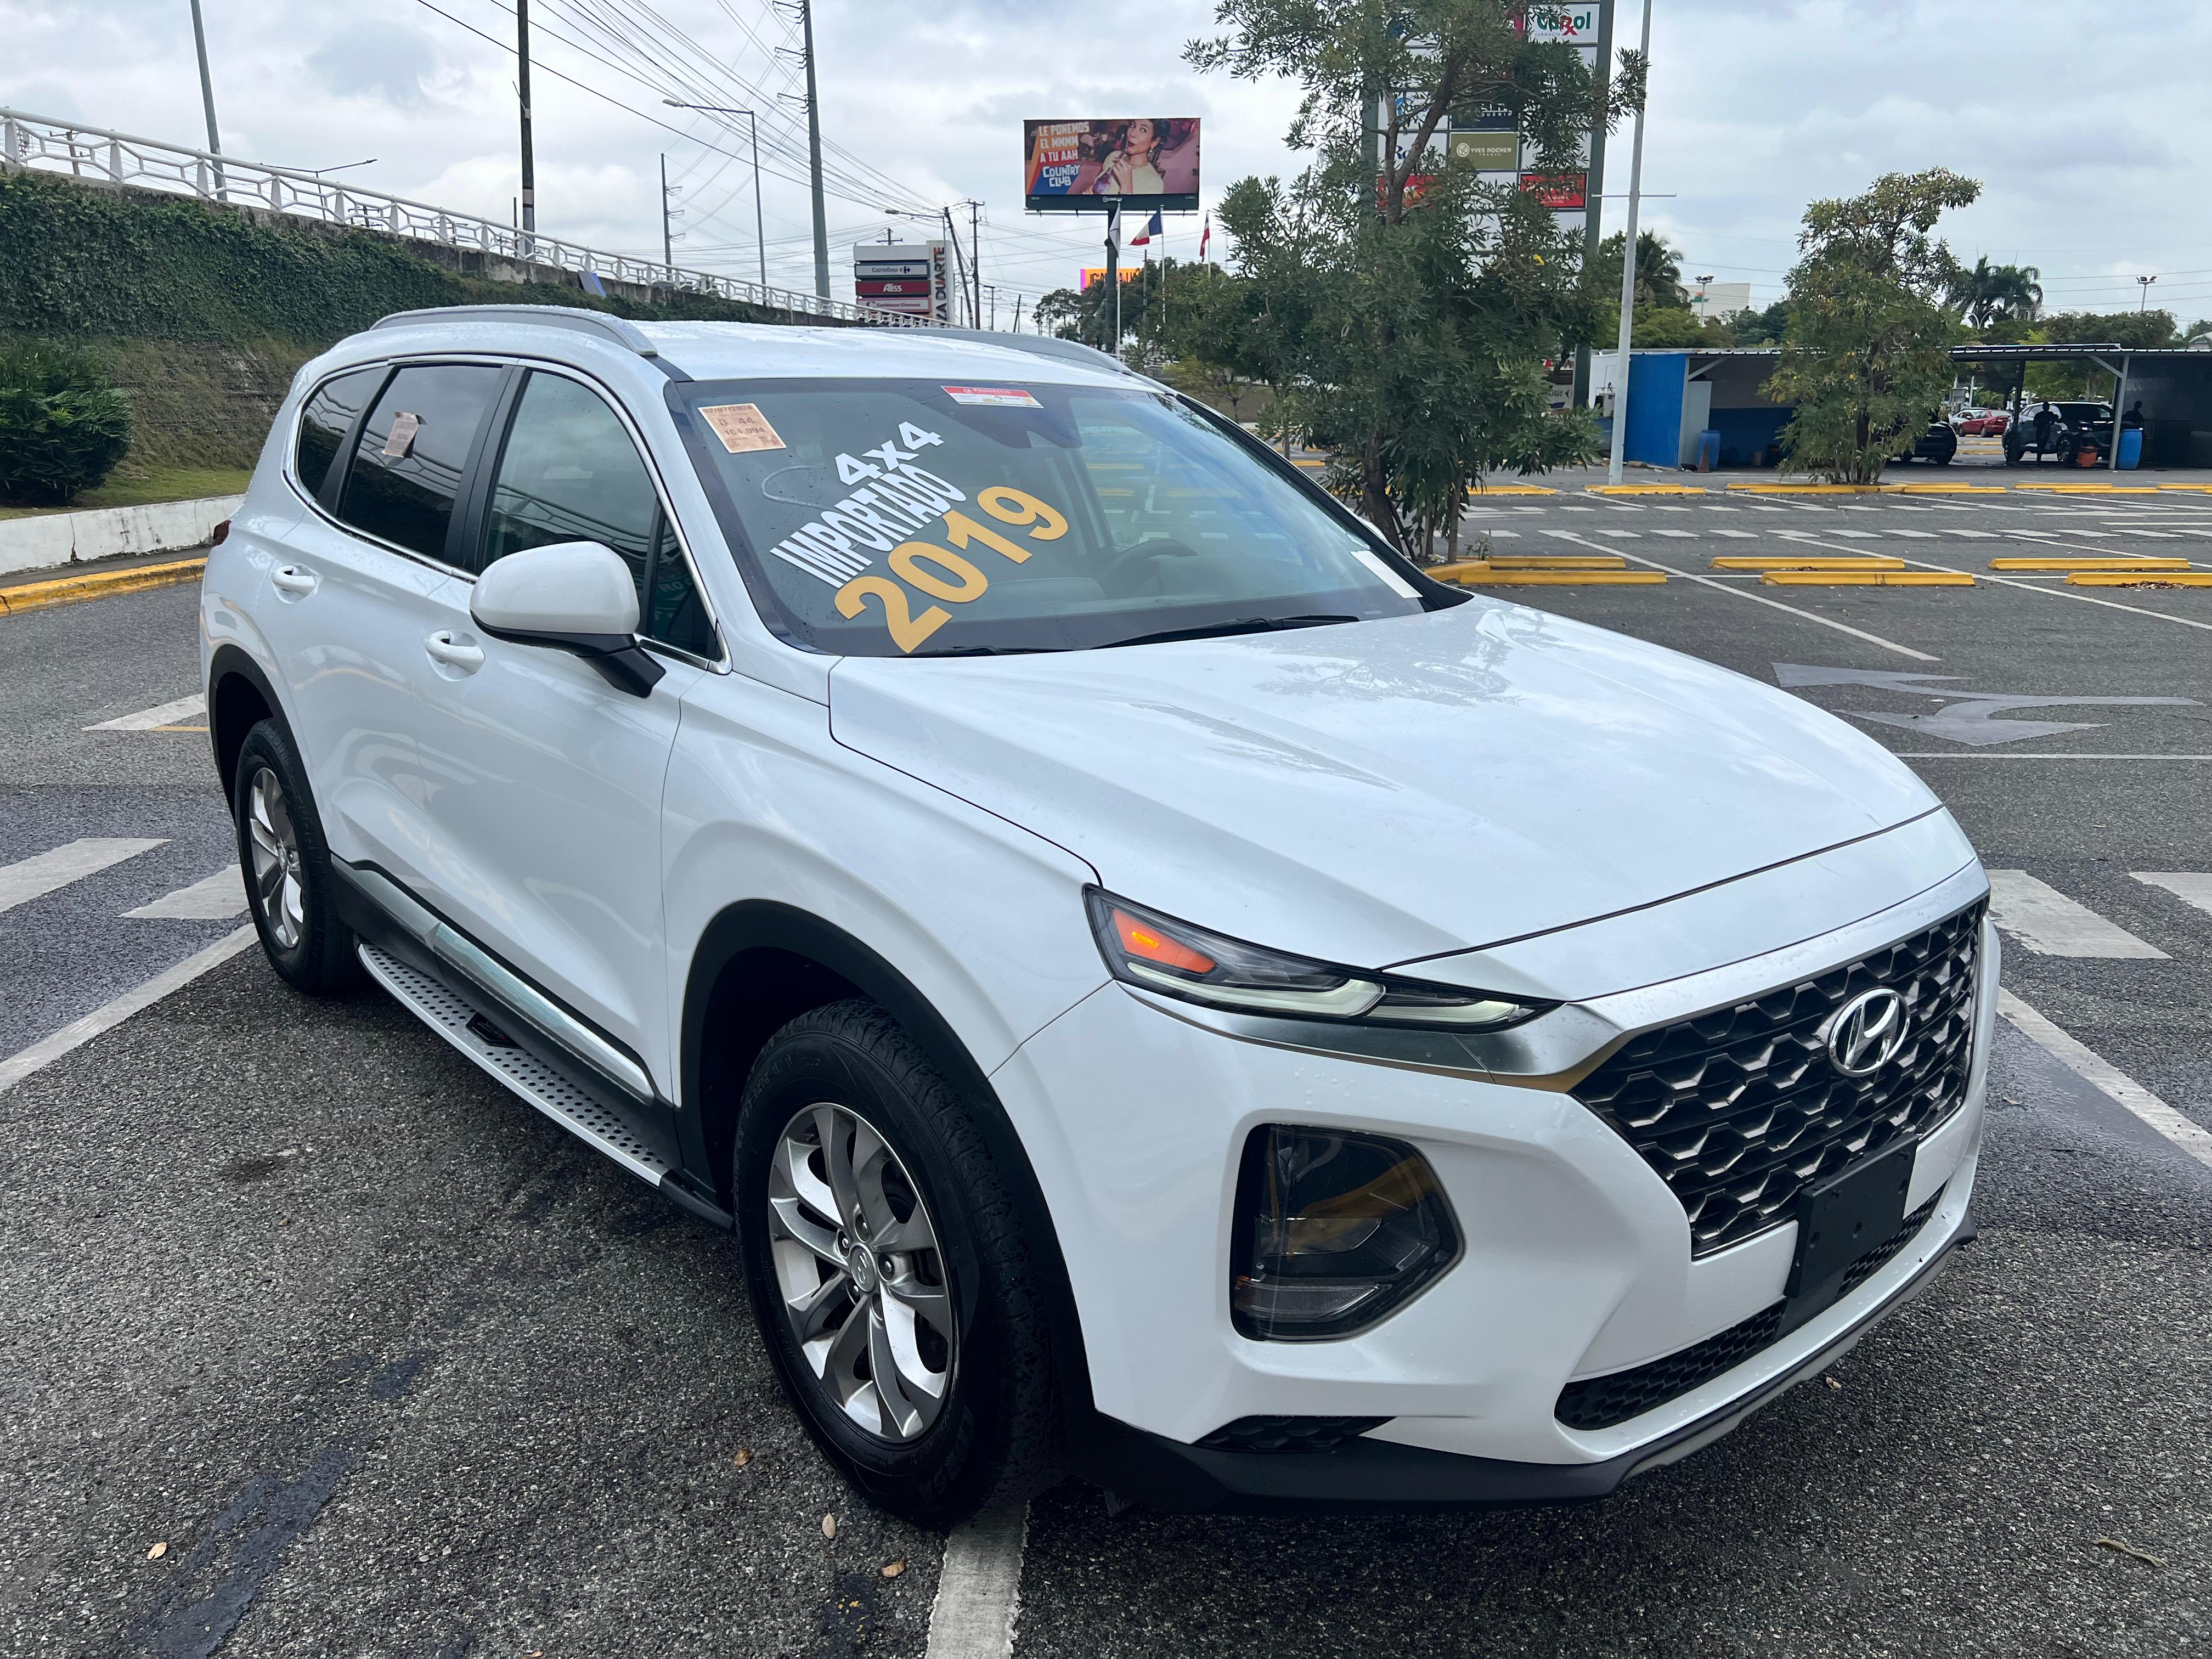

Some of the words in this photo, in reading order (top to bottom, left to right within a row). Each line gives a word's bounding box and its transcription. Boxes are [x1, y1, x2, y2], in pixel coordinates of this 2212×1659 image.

[1039, 126, 1049, 136] LE
[1051, 122, 1090, 135] PONEMOS
[1040, 139, 1049, 149] EL
[1052, 136, 1079, 148] MMMM
[1040, 153, 1046, 162] A
[1048, 151, 1059, 162] TU
[1061, 149, 1078, 161] AAH
[1043, 165, 1080, 178] COUNTRY
[1049, 176, 1071, 187] CLUB
[933, 247, 946, 300] DUARTE
[883, 283, 902, 292] Aliss
[770, 463, 966, 589] IMPORTADO
[834, 486, 1068, 653] 2019
